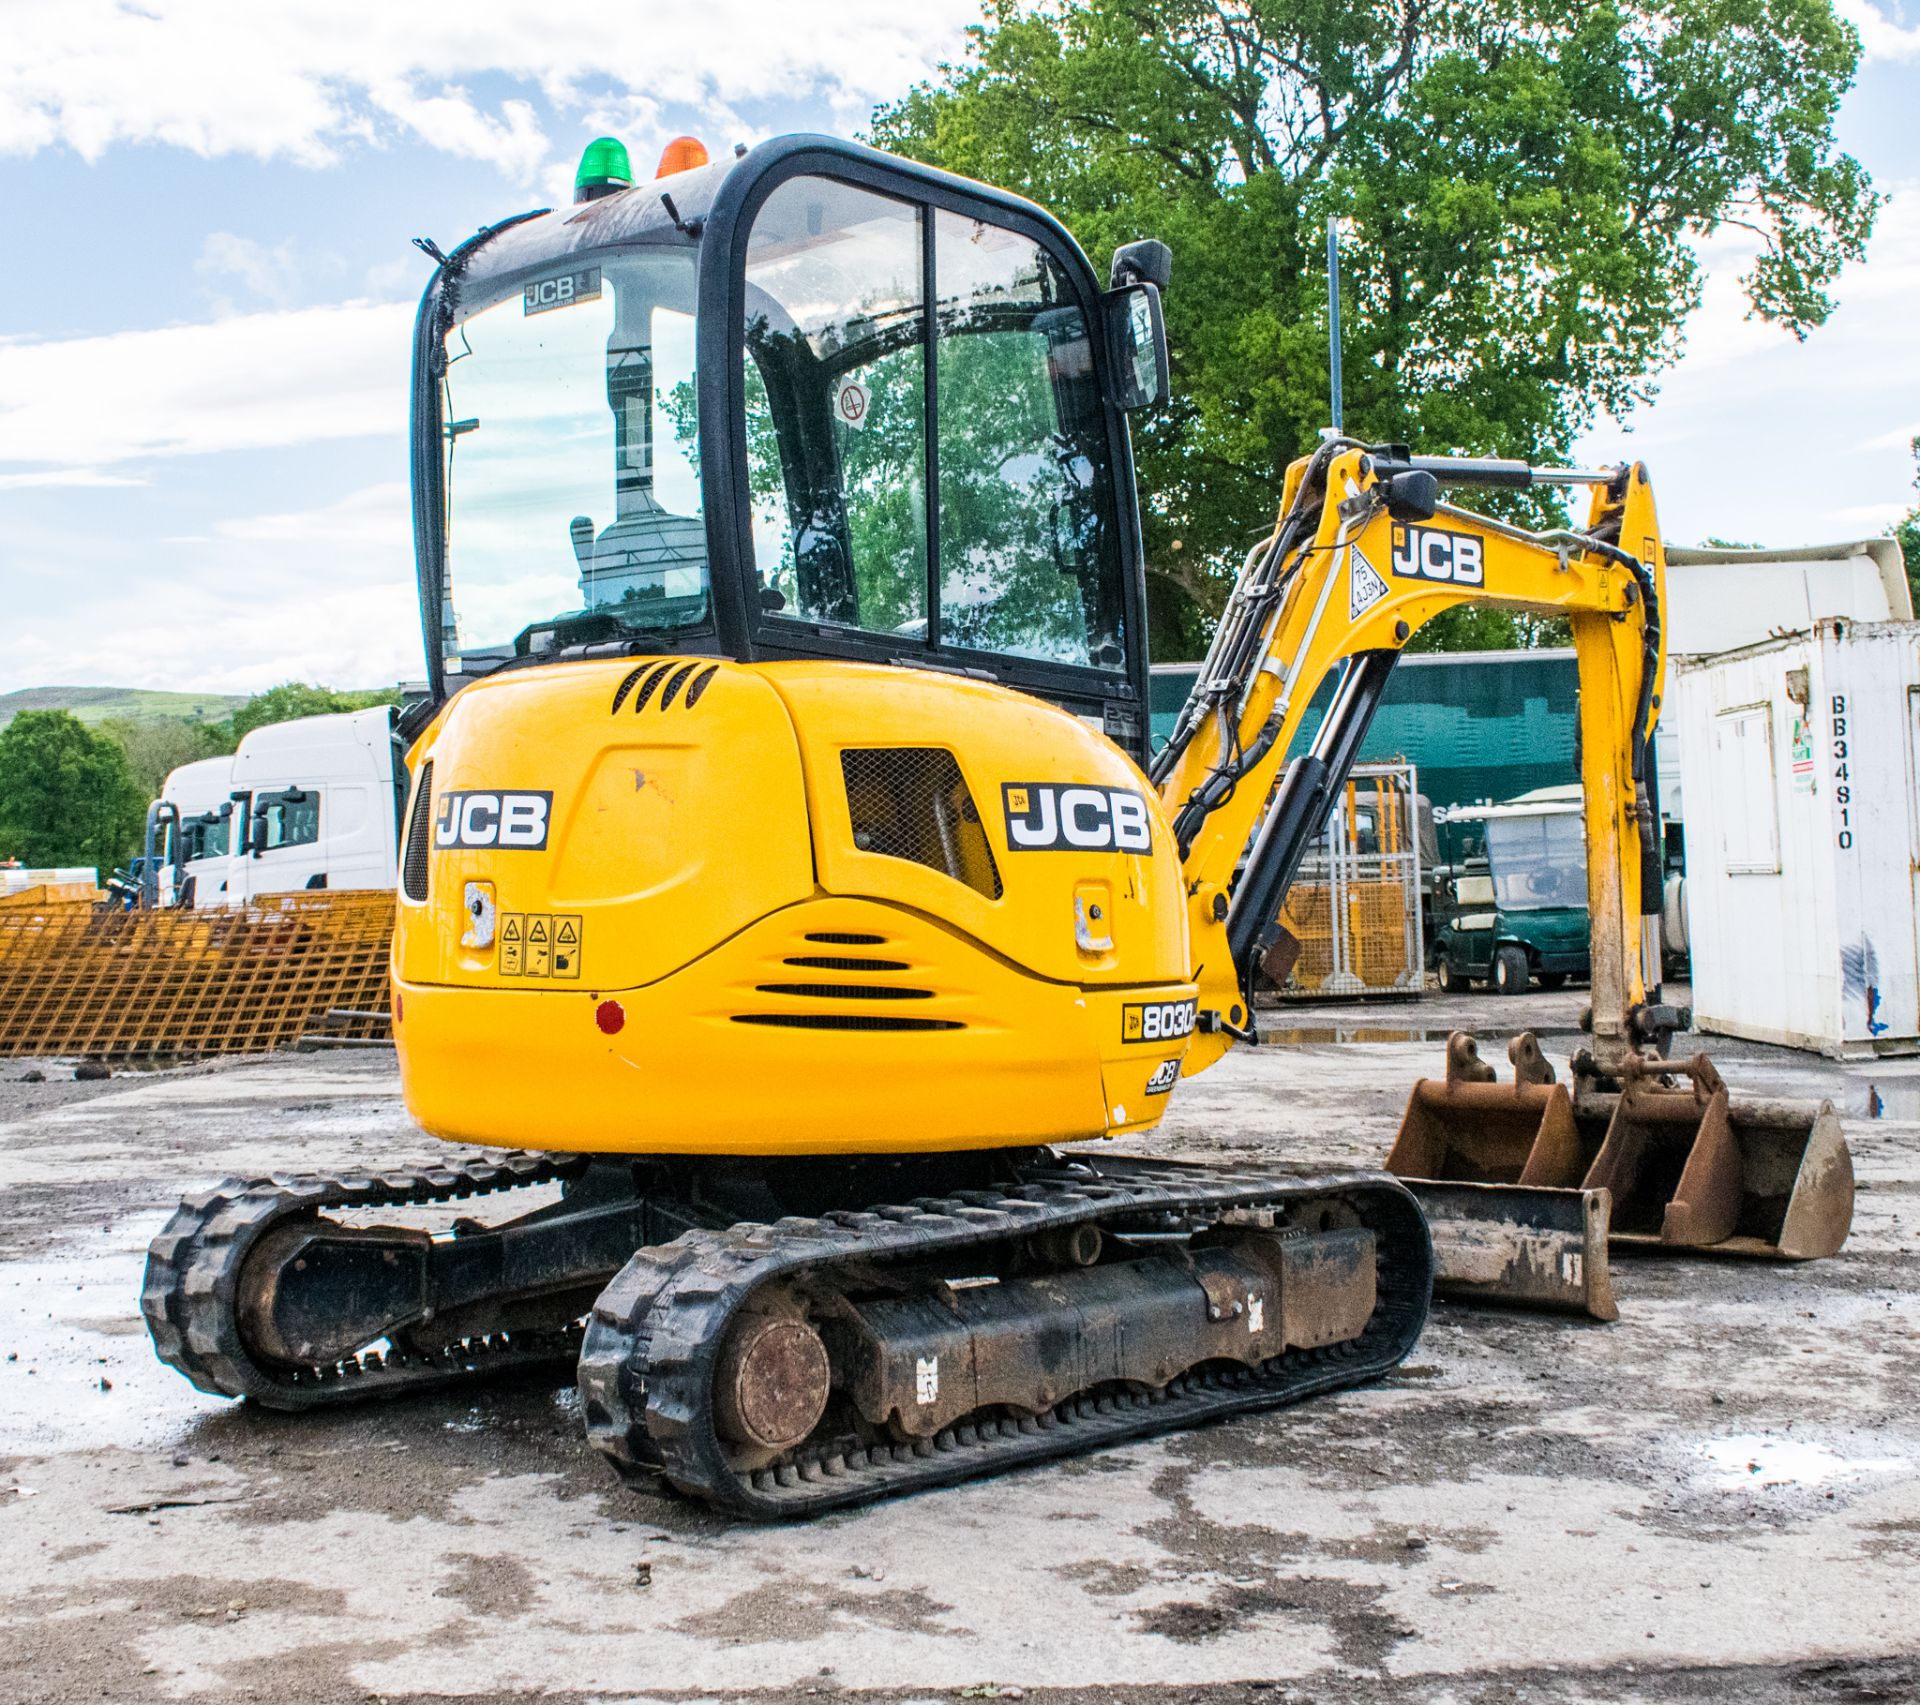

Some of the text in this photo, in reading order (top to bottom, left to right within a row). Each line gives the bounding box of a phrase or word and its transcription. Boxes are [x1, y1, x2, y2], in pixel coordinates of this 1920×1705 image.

[526, 276, 574, 307] JCB
[1355, 565, 1368, 582] 75
[1393, 529, 1482, 583] JCB
[436, 794, 548, 845] JCB
[1010, 788, 1150, 849] JCB
[1148, 1061, 1176, 1085] JCB
